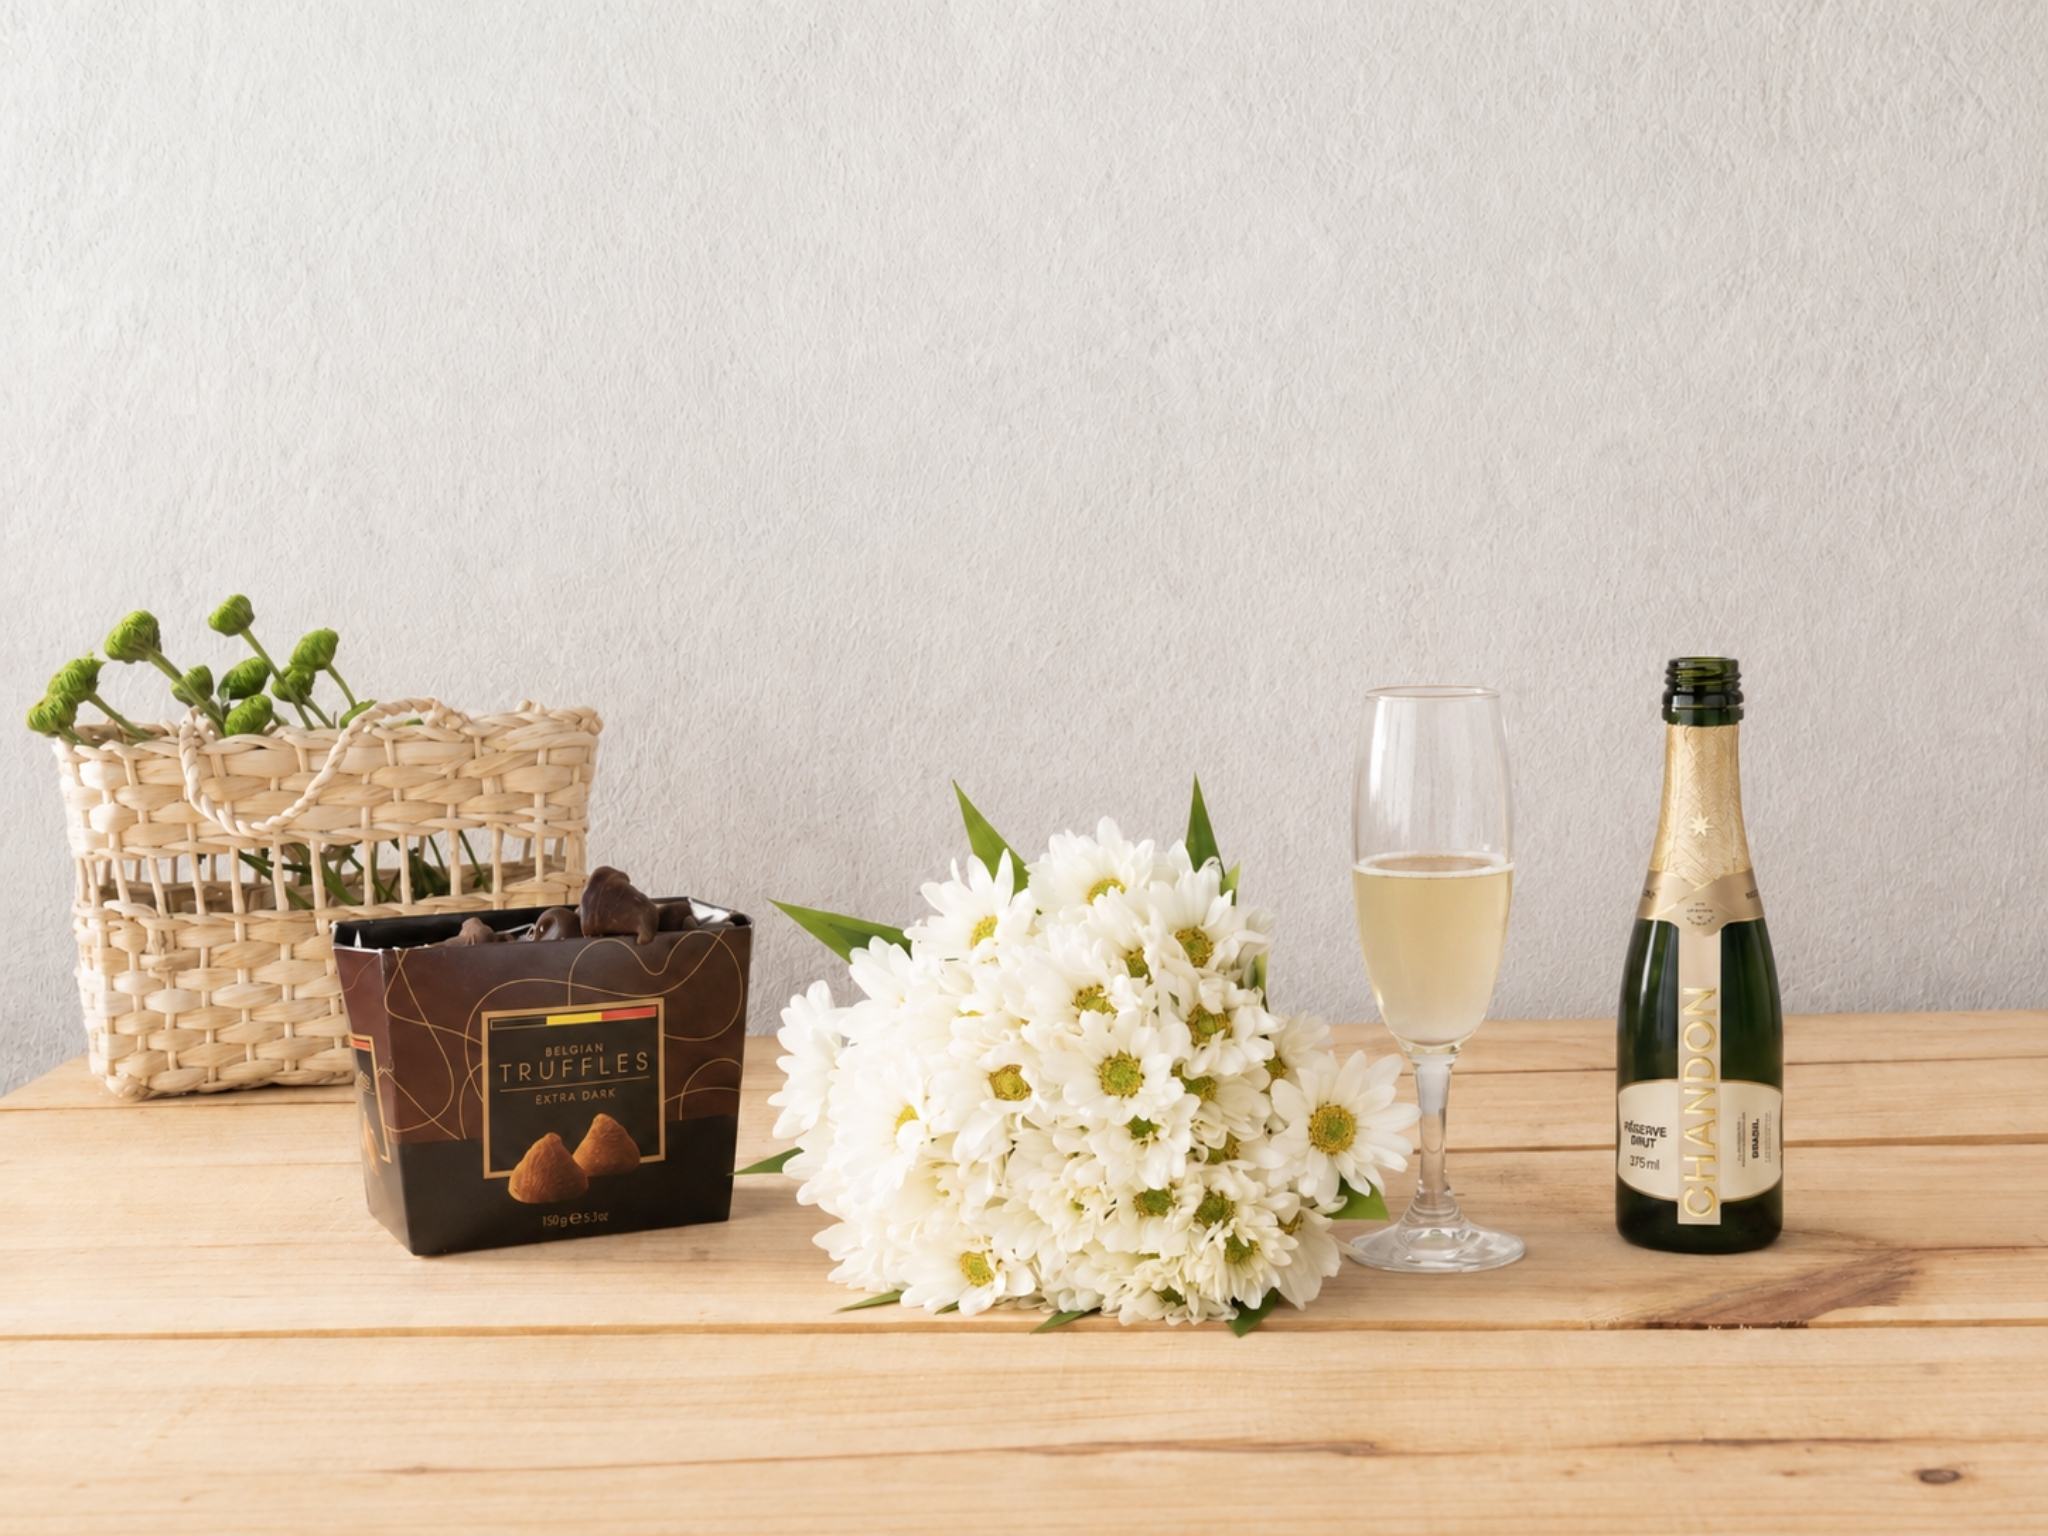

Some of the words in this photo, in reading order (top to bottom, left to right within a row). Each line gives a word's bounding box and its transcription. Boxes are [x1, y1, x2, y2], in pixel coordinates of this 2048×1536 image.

[545, 1043, 604, 1058] BELGIAN
[499, 1051, 649, 1083] TRUFFLES
[535, 1091, 576, 1106] EXTRA
[582, 1087, 616, 1102] DARK
[1683, 987, 1717, 1218] CHANDON
